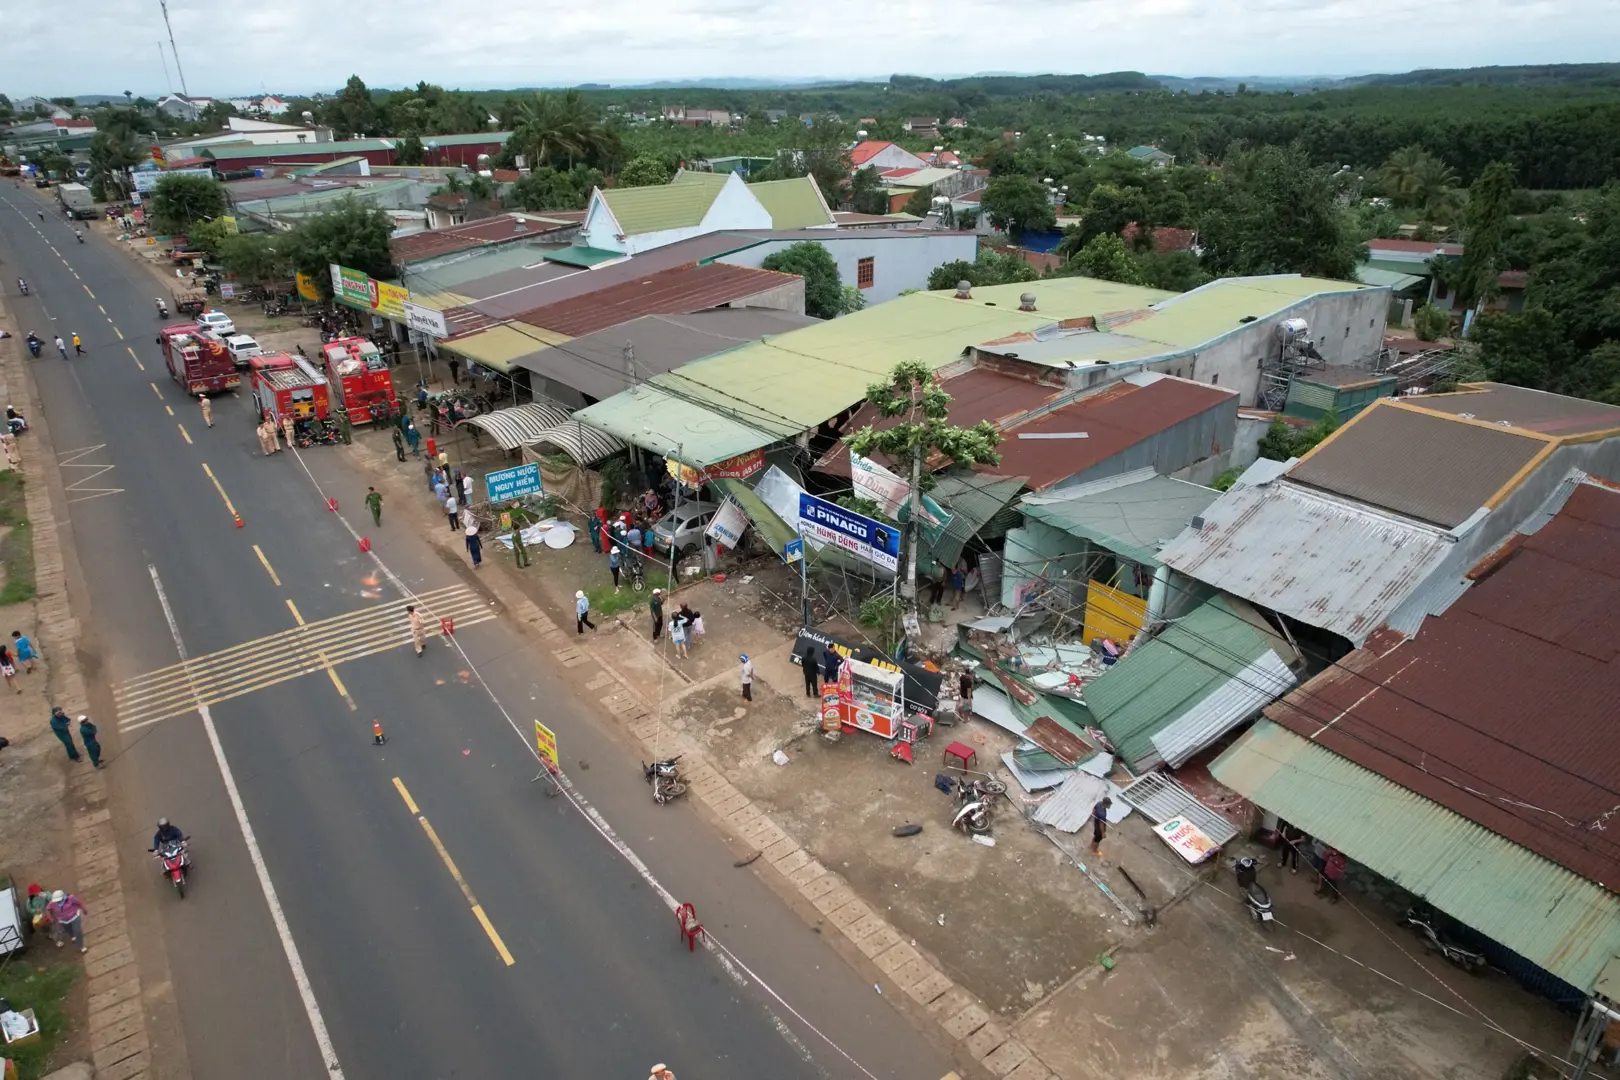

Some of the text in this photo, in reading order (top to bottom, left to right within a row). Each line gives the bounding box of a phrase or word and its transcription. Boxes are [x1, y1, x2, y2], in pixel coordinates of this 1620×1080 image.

[517, 465, 537, 477] NƯỚC
[494, 474, 535, 493] NGUY HIỂM
[513, 487, 532, 496] TRÁNH
[816, 509, 868, 538] PINACO
